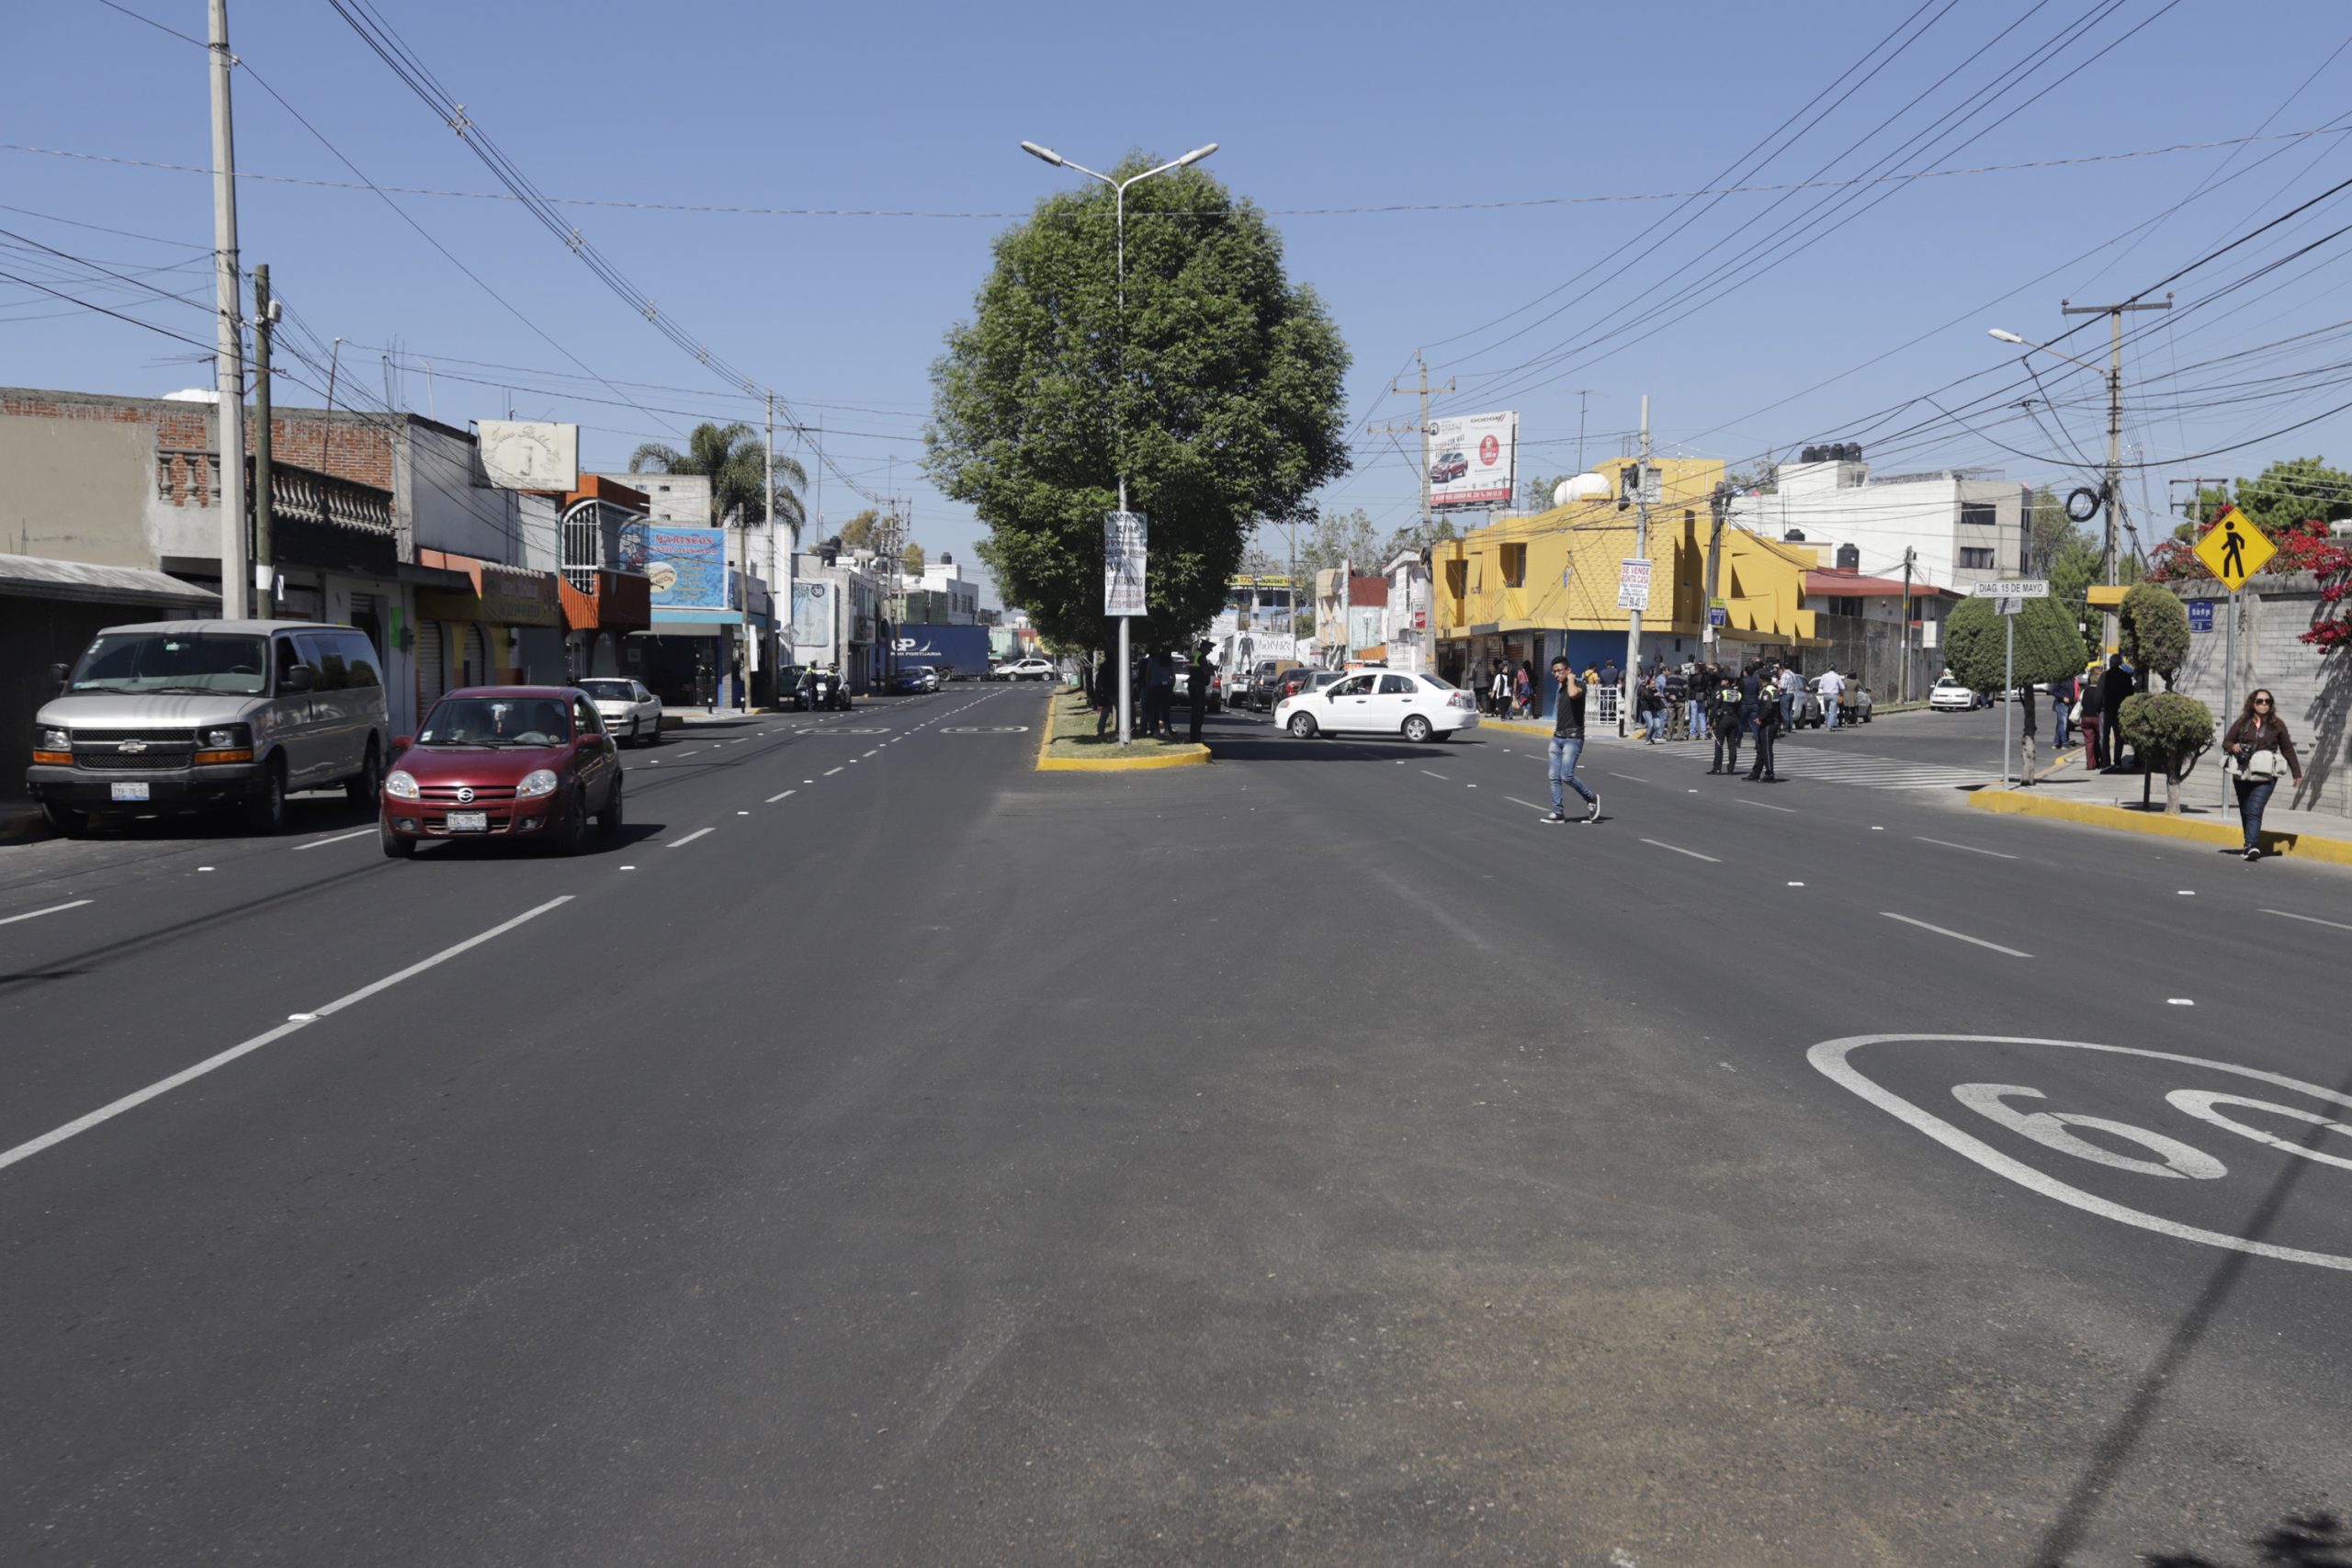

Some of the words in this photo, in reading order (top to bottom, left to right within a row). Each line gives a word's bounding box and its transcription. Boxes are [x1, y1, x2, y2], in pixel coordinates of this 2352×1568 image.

[655, 535, 714, 545] MARISCOS
[1631, 567, 1649, 575] VENDE
[1979, 583, 1998, 592] DIAG.
[2002, 583, 2008, 592] 15
[2011, 583, 2020, 592] DE
[2022, 583, 2043, 592] MAYO
